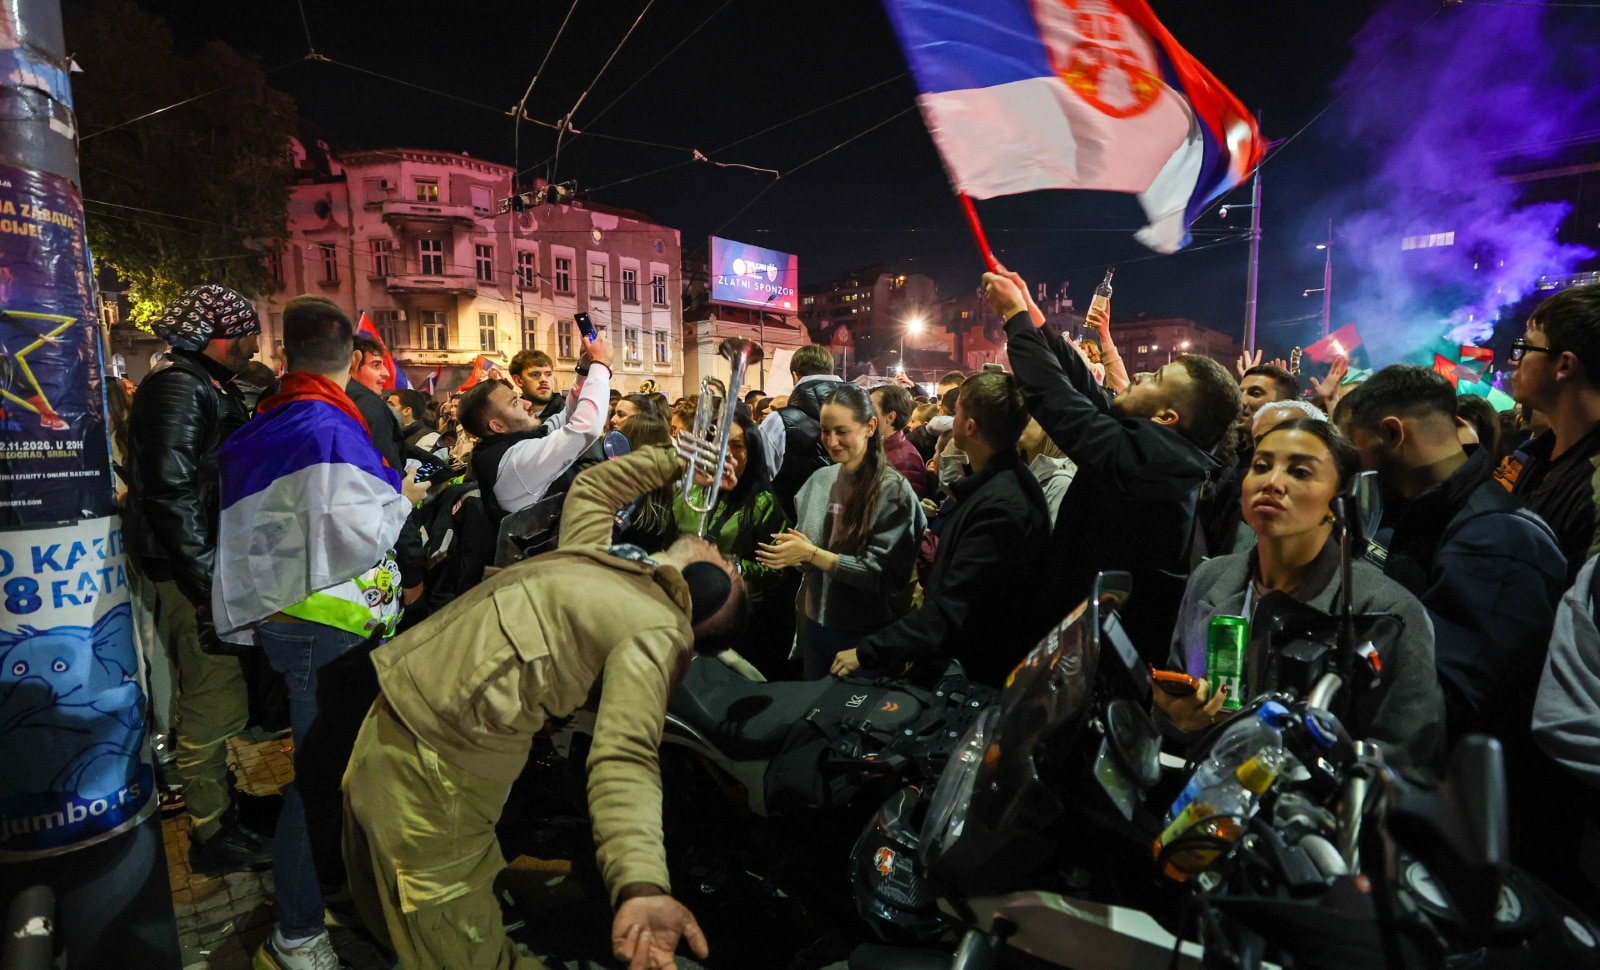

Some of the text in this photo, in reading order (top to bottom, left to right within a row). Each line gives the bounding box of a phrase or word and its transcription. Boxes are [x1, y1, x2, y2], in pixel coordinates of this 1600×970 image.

[0, 200, 75, 230] A ZABAVA
[718, 275, 750, 289] ZLATNI
[754, 282, 794, 297] SPONZOR
[47, 450, 78, 458] SRBIJA
[56, 441, 64, 450] U
[1, 782, 141, 842] jumbo.rs
